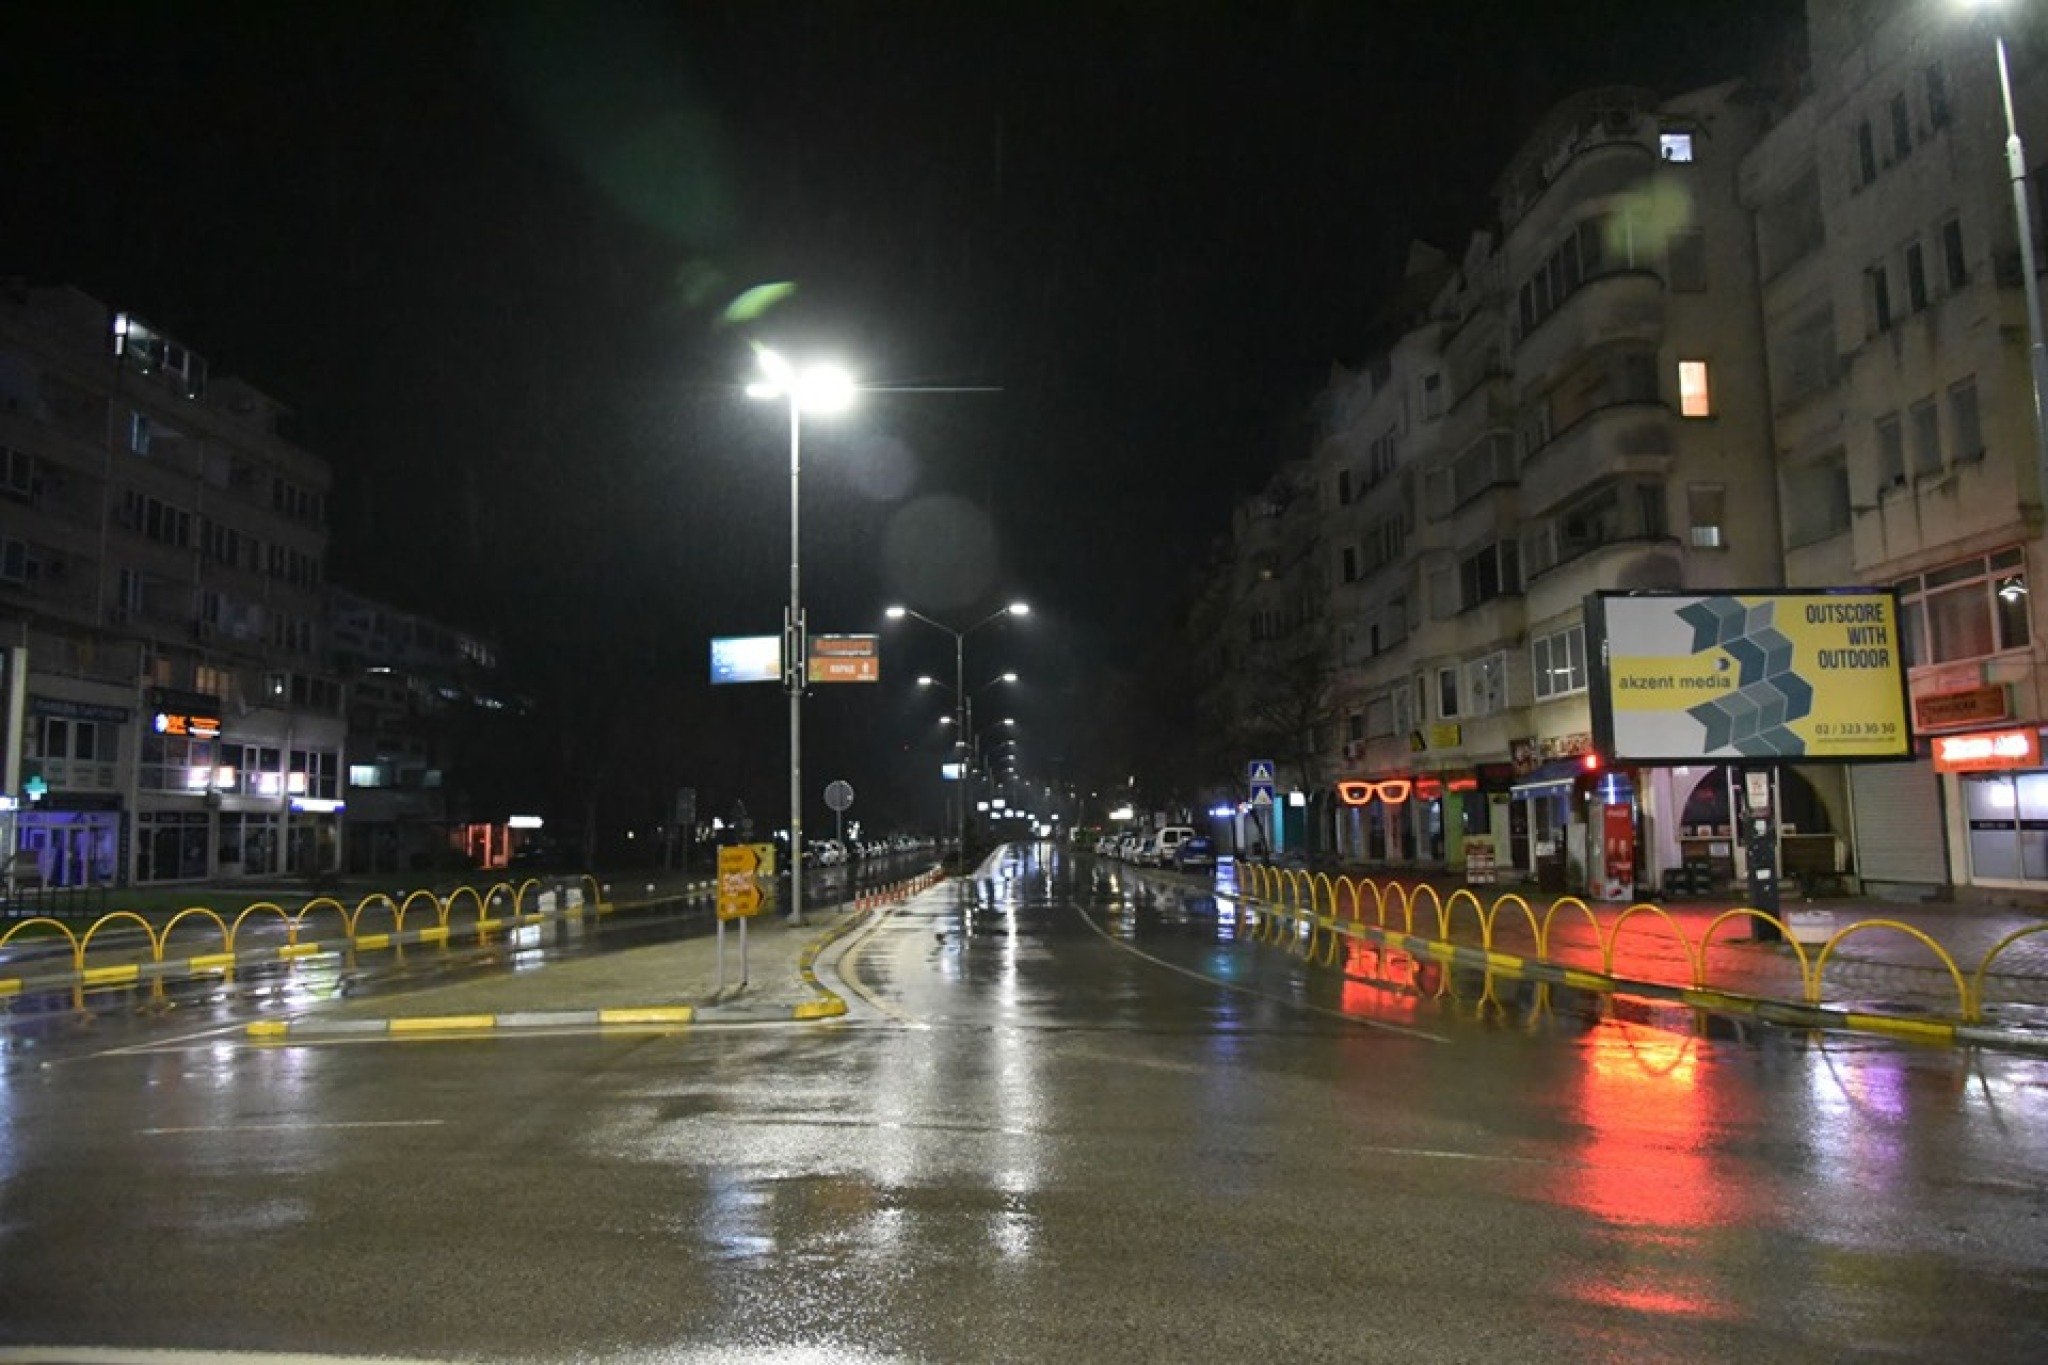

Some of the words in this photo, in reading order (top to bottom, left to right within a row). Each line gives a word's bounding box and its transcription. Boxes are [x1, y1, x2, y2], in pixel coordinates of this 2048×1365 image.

[1806, 603, 1884, 623] OUTSCORE
[1848, 627, 1888, 645] WITH
[1818, 648, 1890, 668] OUTDOOR
[1620, 674, 1675, 689] akzent
[1680, 674, 1731, 689] media
